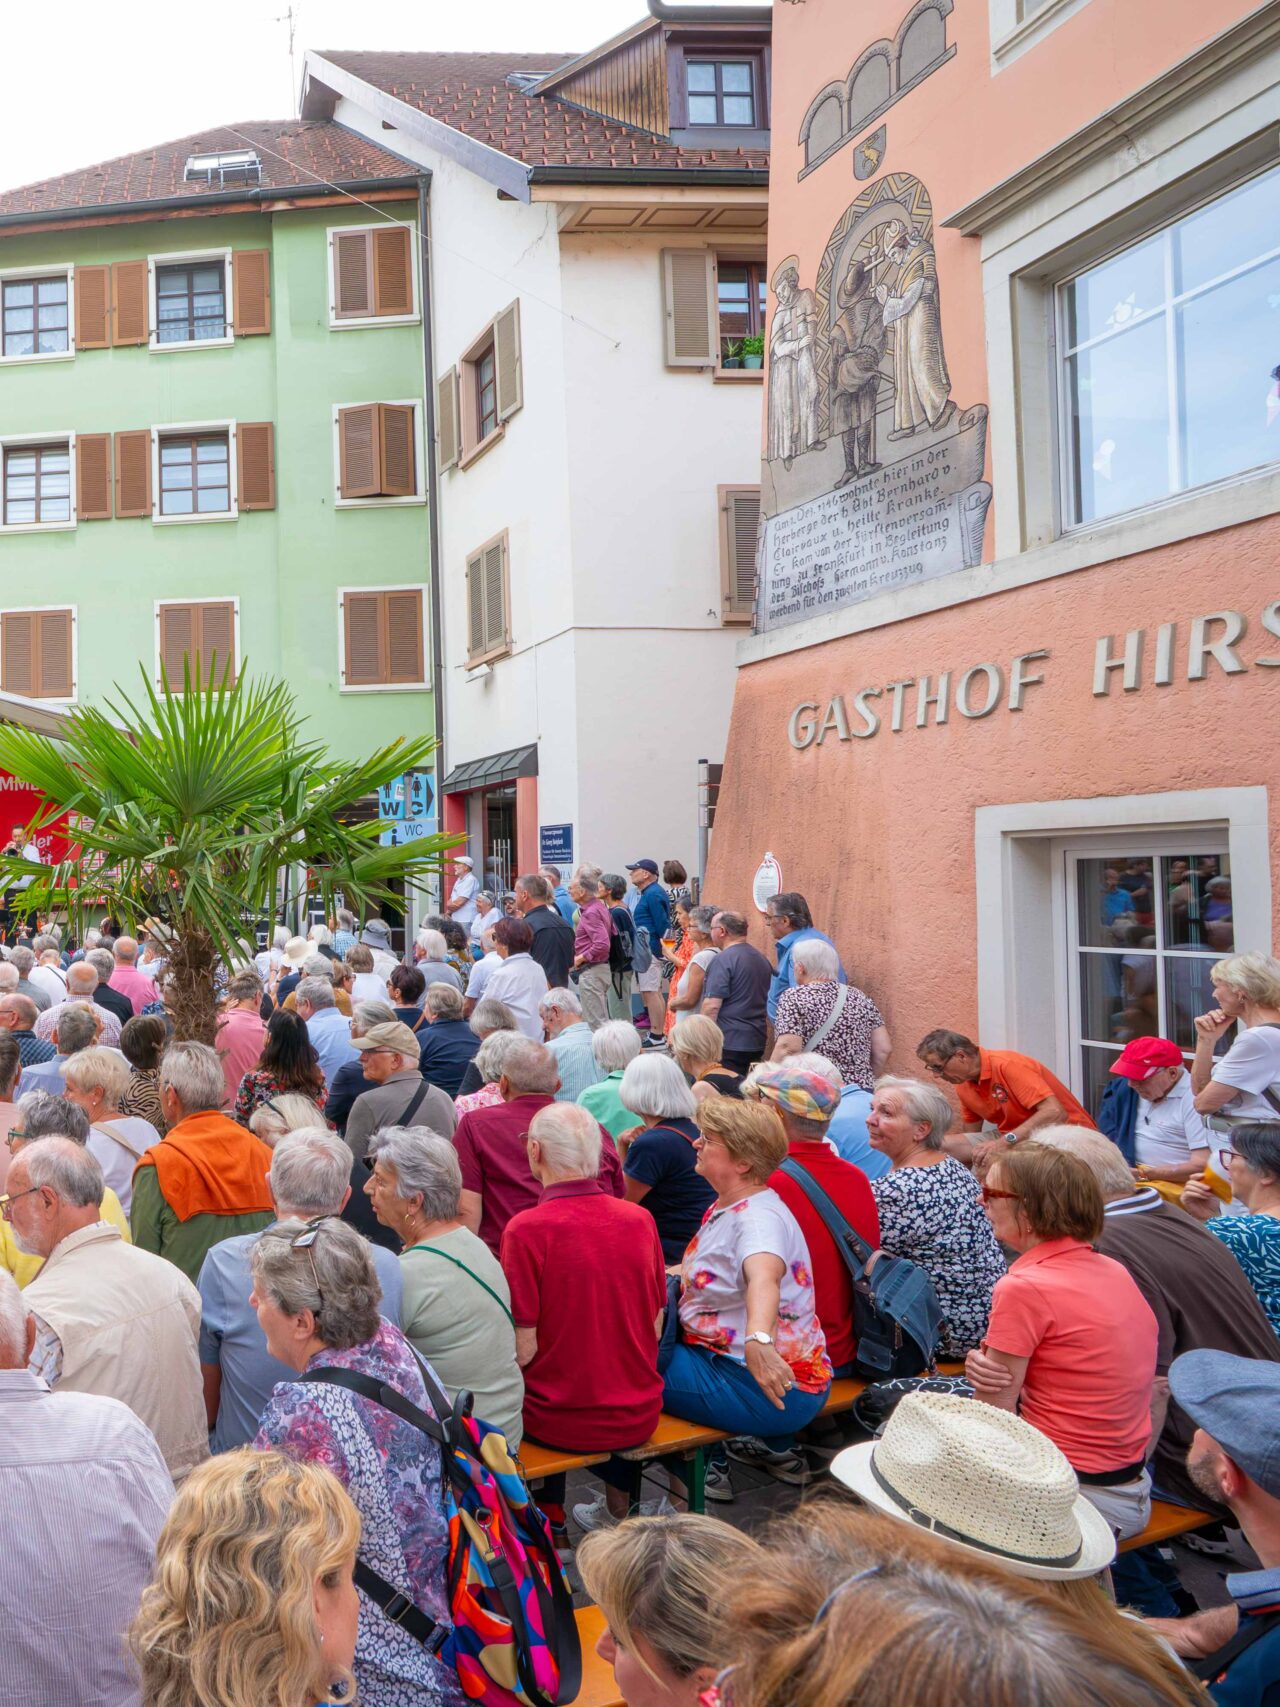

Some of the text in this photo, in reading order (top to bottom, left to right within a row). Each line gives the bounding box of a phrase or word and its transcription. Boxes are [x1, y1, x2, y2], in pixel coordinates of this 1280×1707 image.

[839, 478, 880, 504] wohnte
[883, 466, 909, 484] hier
[911, 459, 925, 472] in
[927, 448, 949, 464] der
[821, 512, 839, 525] der
[876, 467, 939, 503] Bernhard
[773, 533, 827, 561] Clairvaux
[870, 541, 882, 554] in
[885, 517, 950, 547] Begleitung
[771, 592, 786, 604] des
[891, 536, 947, 563] Konstanz
[773, 563, 785, 576] Er
[834, 538, 852, 551] der
[803, 596, 816, 611] für
[817, 590, 834, 605] den
[787, 648, 1051, 750] GASTHOF
[381, 800, 424, 816] WC
[404, 824, 423, 836] WC
